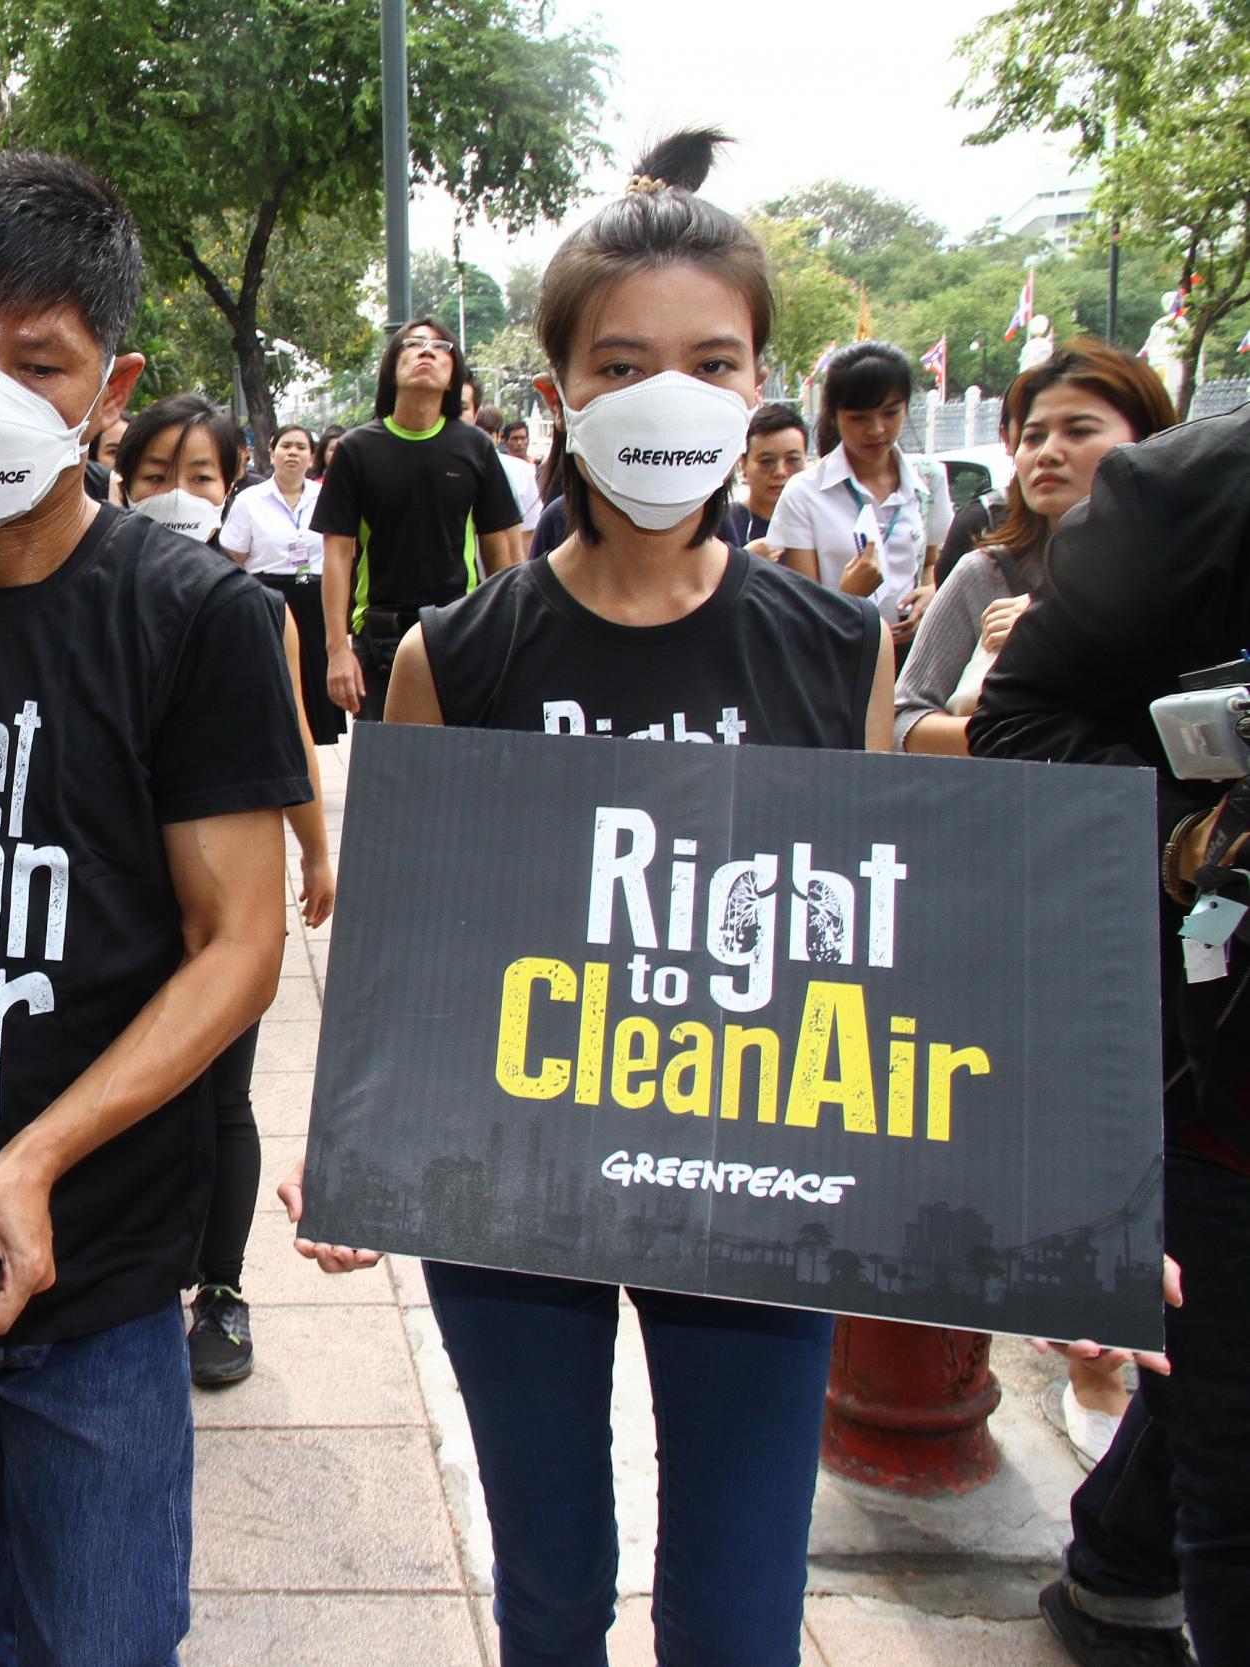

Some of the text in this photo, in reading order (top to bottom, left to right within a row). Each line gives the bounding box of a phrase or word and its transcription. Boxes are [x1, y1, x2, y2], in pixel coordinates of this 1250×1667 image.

[616, 448, 723, 466] GREENPEACE
[587, 806, 907, 1014] Right
[628, 953, 689, 1006] to
[601, 1150, 855, 1204] GREENPEACE
